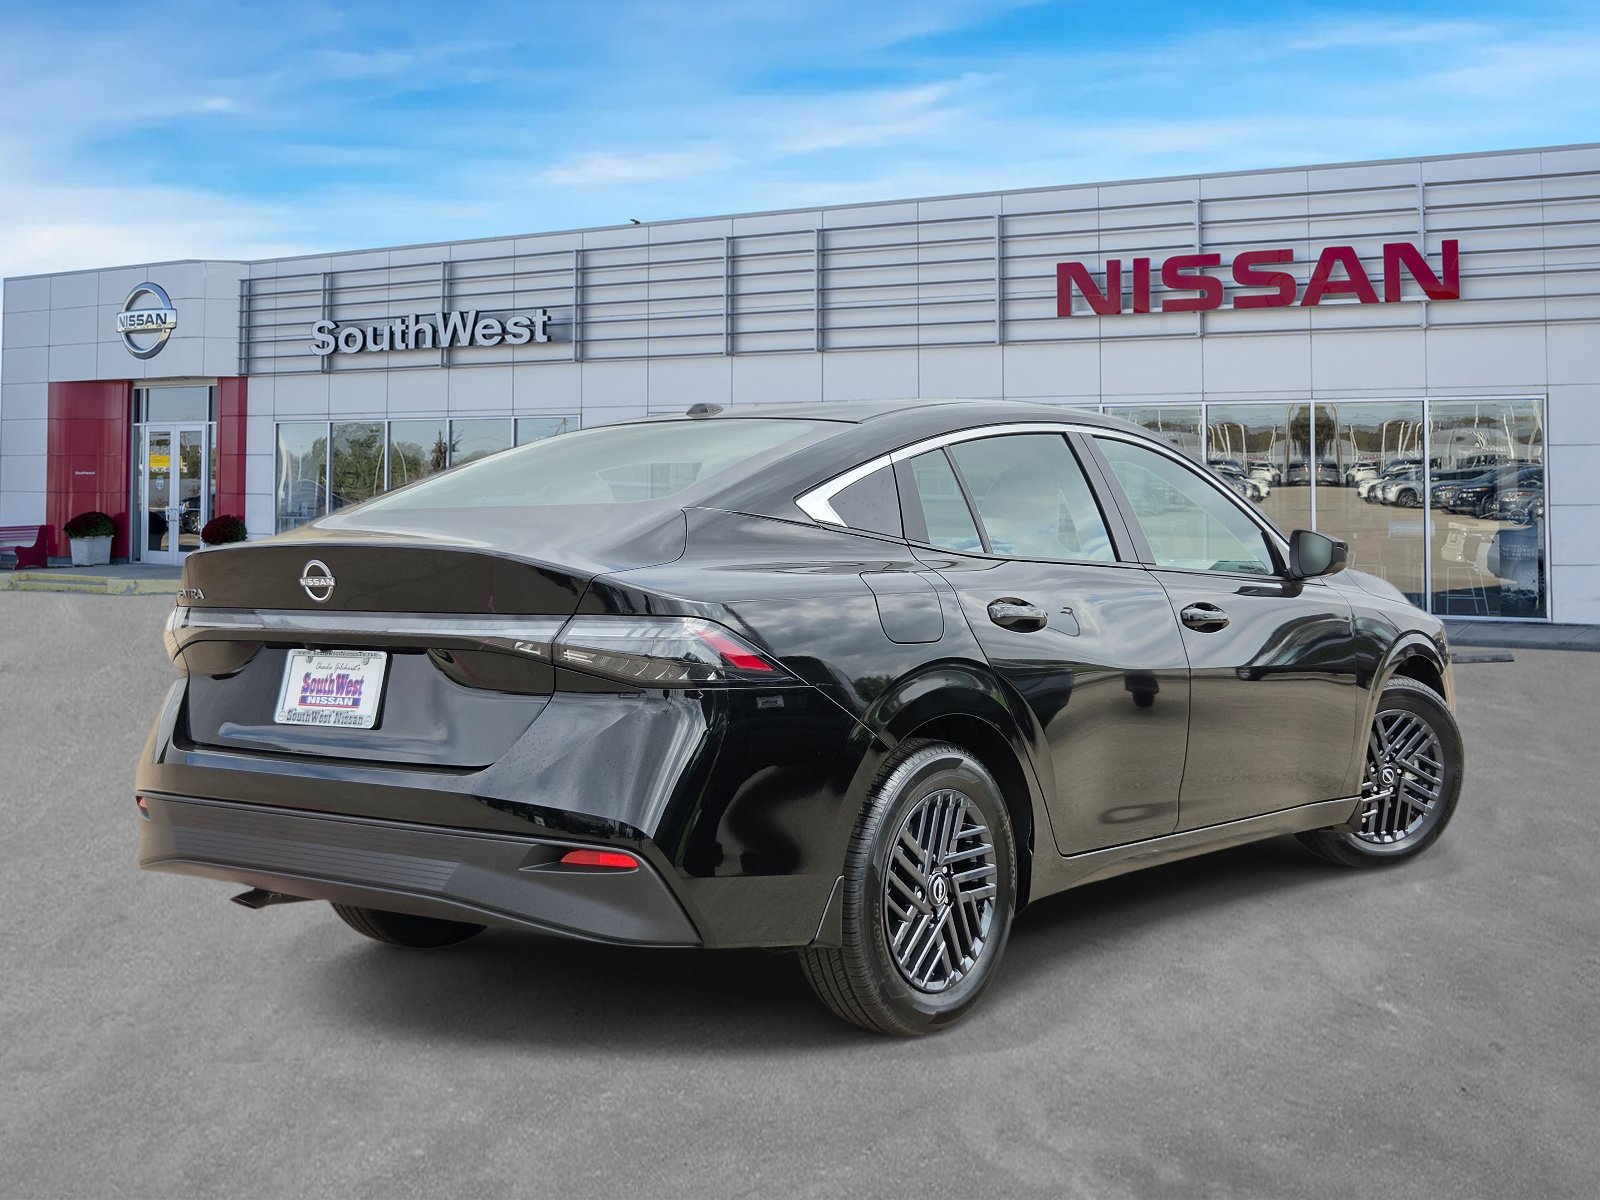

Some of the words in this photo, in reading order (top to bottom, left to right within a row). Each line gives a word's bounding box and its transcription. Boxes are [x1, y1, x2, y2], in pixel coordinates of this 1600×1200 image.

[1056, 239, 1460, 318] NISSAN
[119, 313, 168, 328] NISSAN
[308, 309, 551, 356] SouthWest
[300, 578, 335, 587] NISSAN
[301, 672, 364, 697] SouthWest
[306, 696, 353, 706] NISSAN
[286, 708, 331, 723] SouthWest
[333, 710, 364, 726] Nissan
